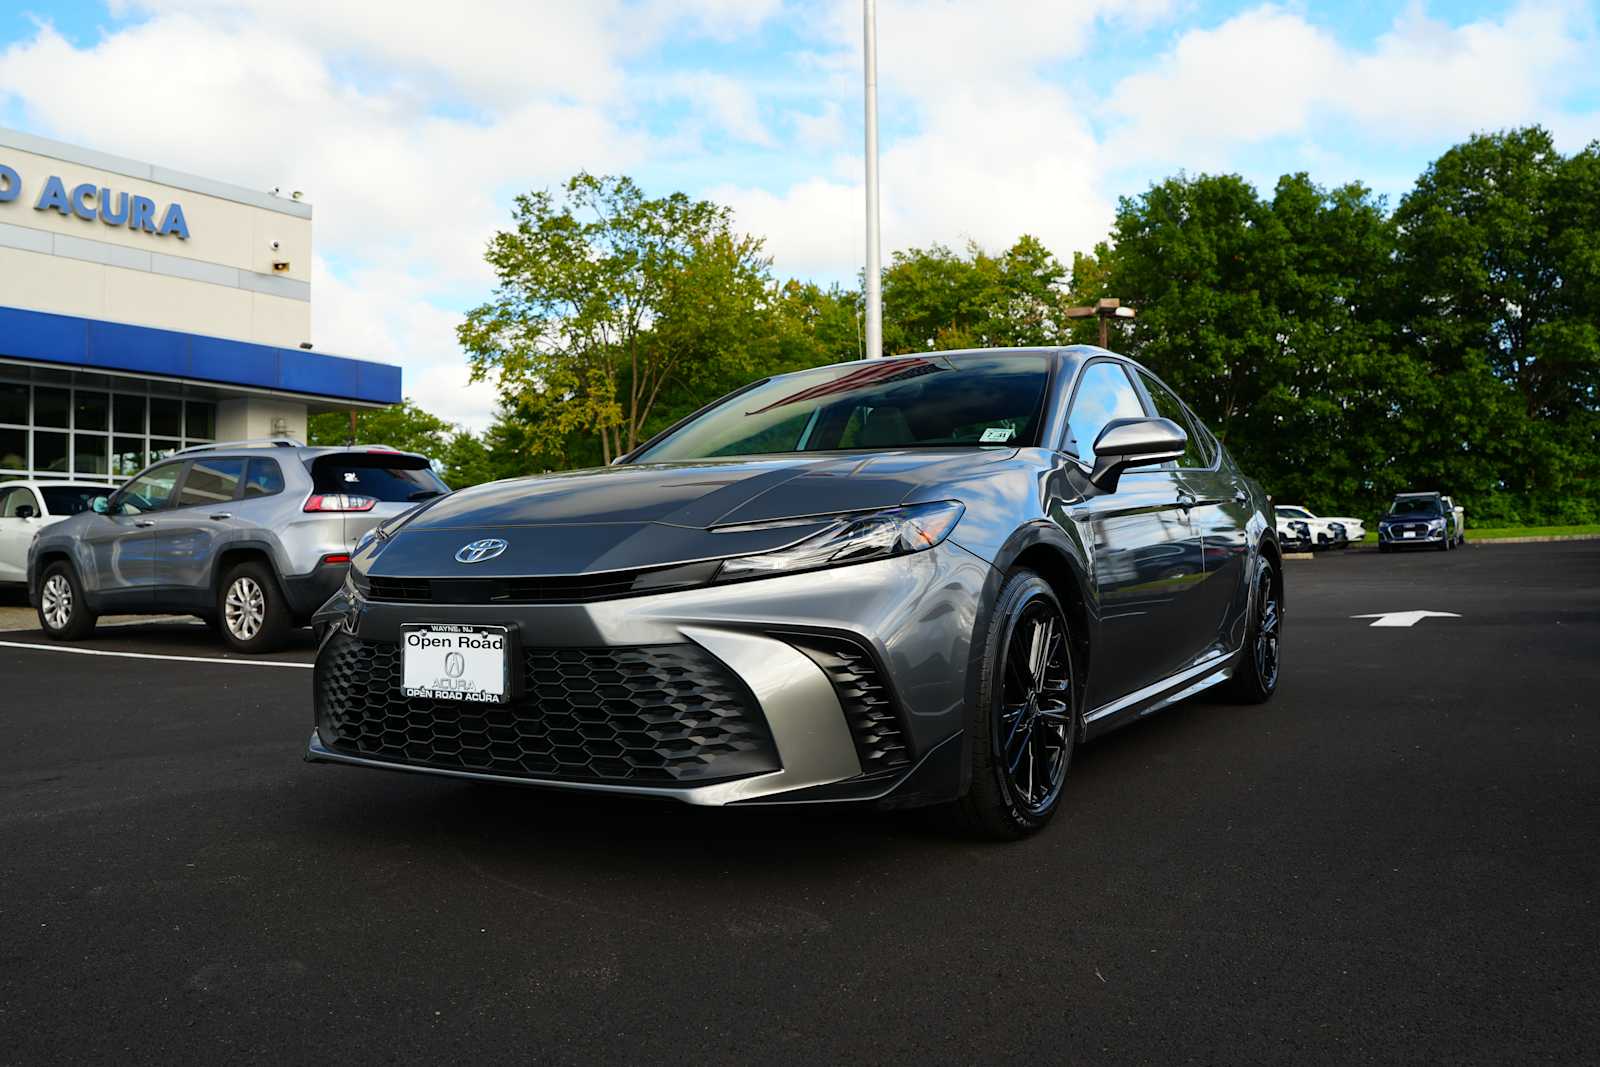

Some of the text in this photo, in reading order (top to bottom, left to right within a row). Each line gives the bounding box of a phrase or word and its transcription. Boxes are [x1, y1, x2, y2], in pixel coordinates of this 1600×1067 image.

[34, 175, 190, 240] ACURA
[407, 634, 503, 650] Open Road
[432, 678, 477, 691] ACURA
[406, 688, 500, 703] OPEN ROAD ACURA
